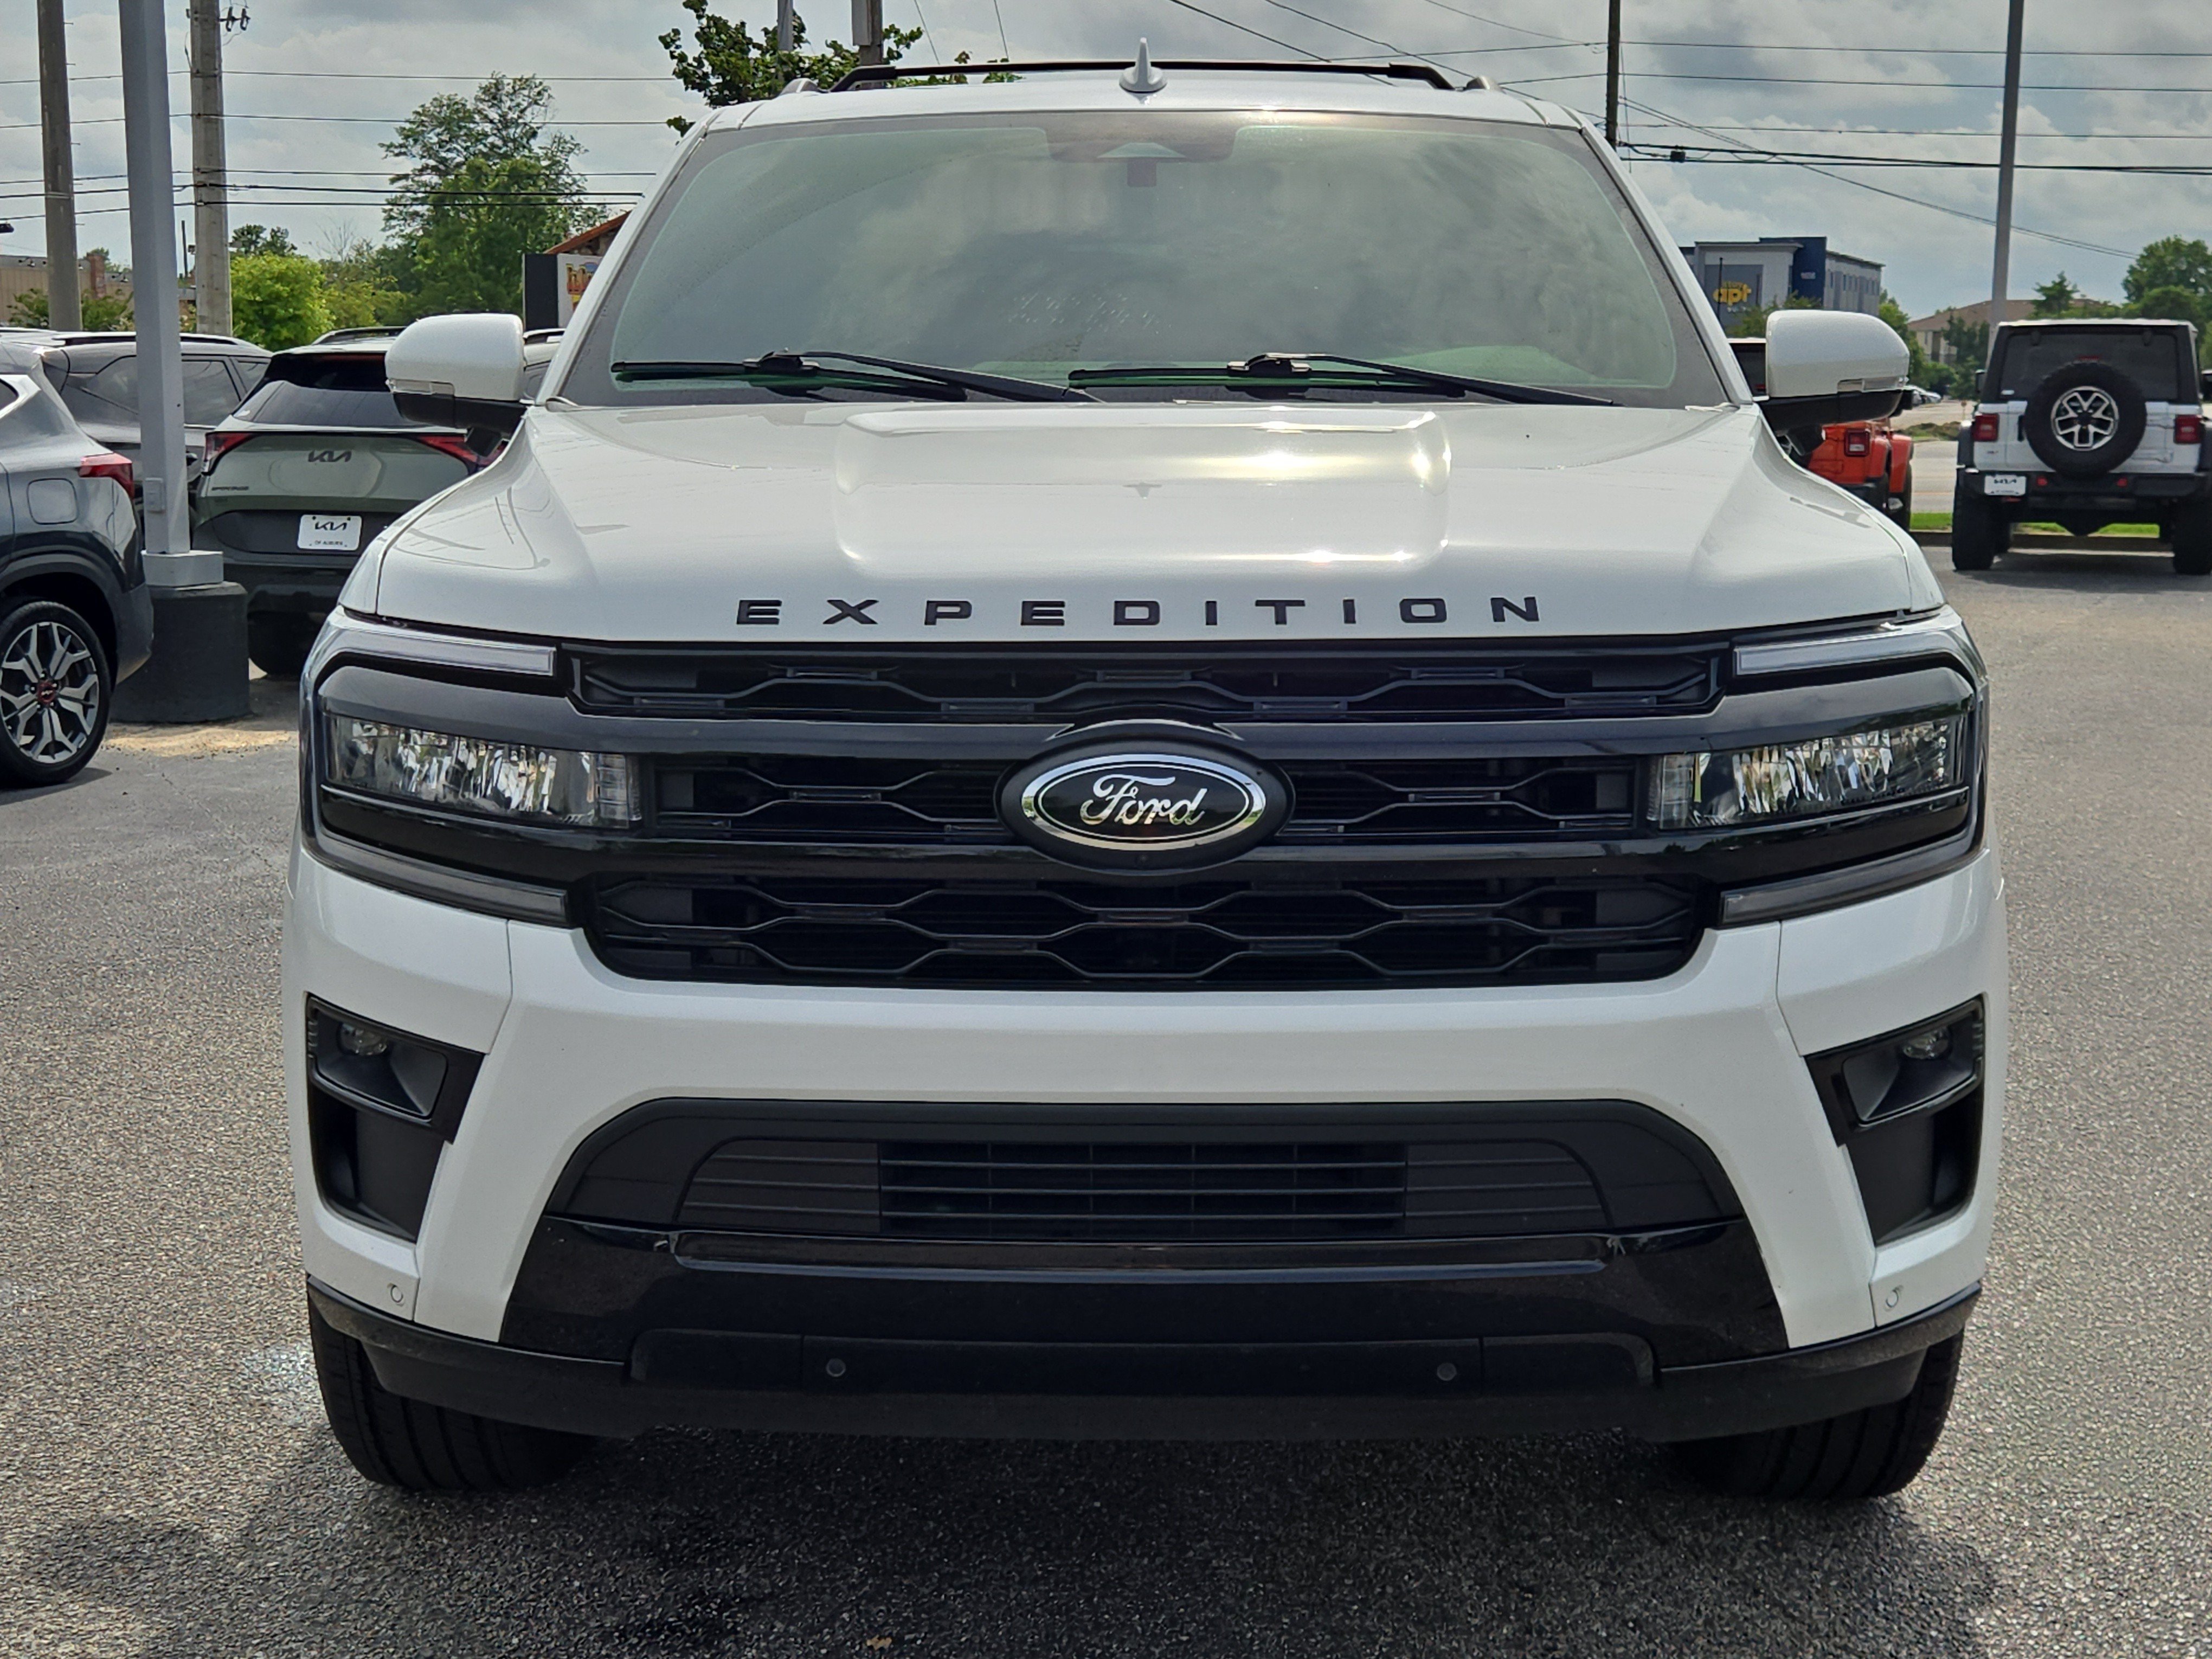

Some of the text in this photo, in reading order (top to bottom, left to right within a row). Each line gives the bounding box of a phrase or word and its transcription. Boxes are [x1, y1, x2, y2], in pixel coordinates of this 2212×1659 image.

[308, 450, 352, 462] KIA
[315, 521, 348, 531] KIA
[736, 596, 1540, 626] EXPEDITION
[1080, 774, 1207, 825] Ford
